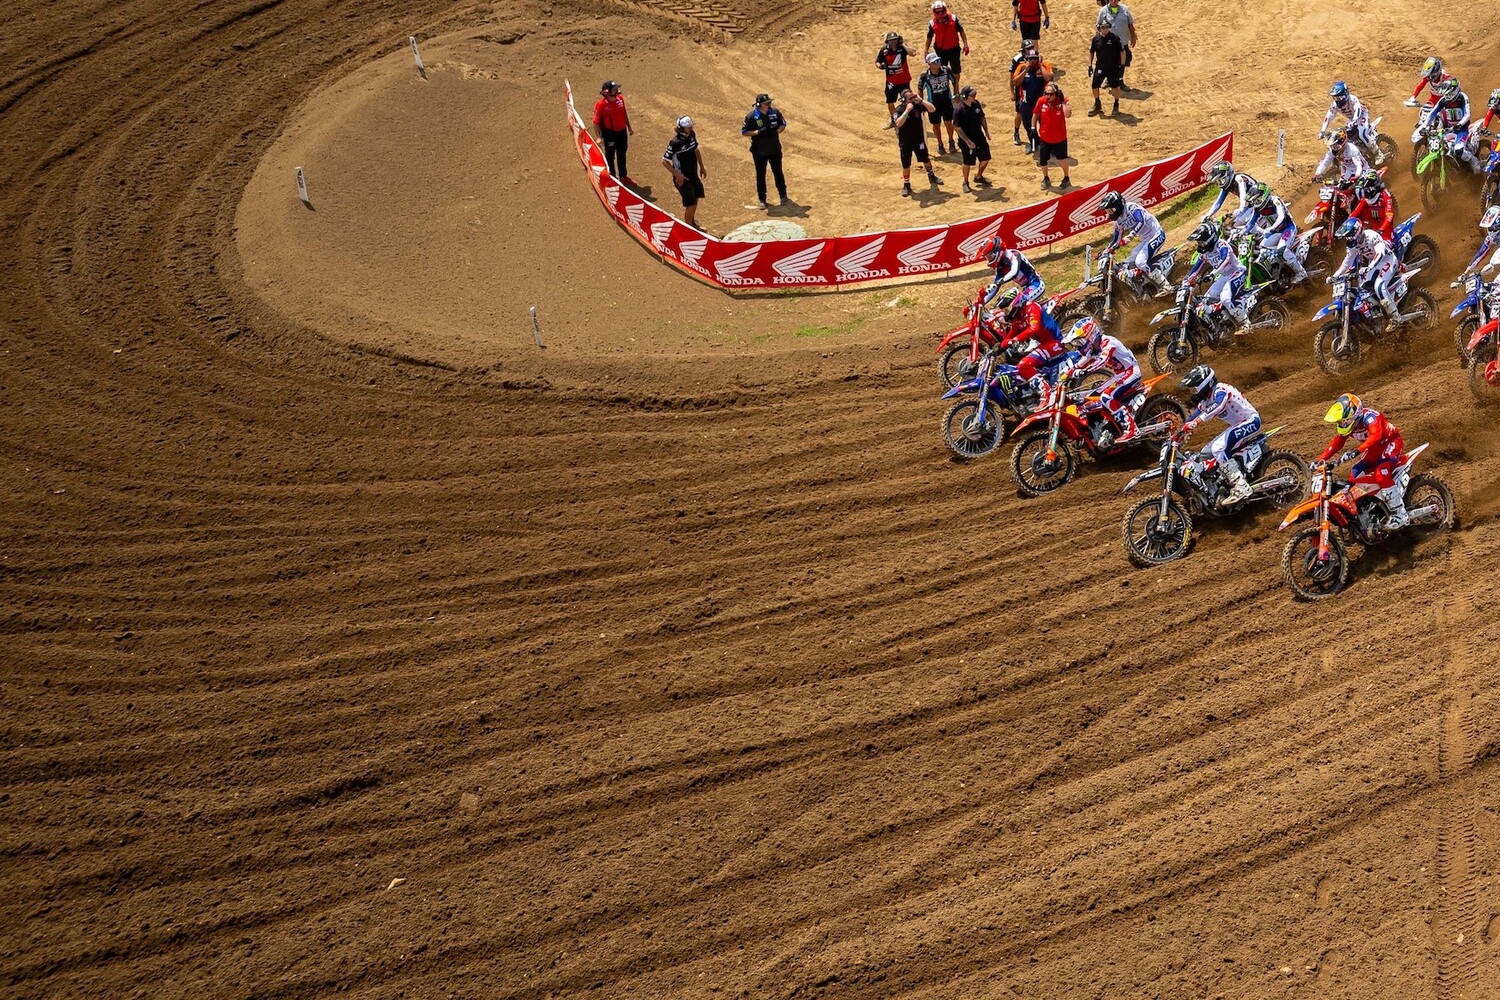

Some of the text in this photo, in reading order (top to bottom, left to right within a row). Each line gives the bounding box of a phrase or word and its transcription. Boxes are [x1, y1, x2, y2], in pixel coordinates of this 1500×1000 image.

[1428, 138, 1441, 150] 36
[1161, 180, 1195, 199] HONDA
[1319, 187, 1334, 200] 25
[1015, 230, 1064, 250] HONDA
[680, 256, 712, 278] HONDA
[897, 260, 952, 274] HONDA
[716, 273, 765, 286] HONDA
[772, 274, 828, 284] HONDA
[835, 268, 891, 282] HONDA
[1234, 423, 1258, 440] FXR
